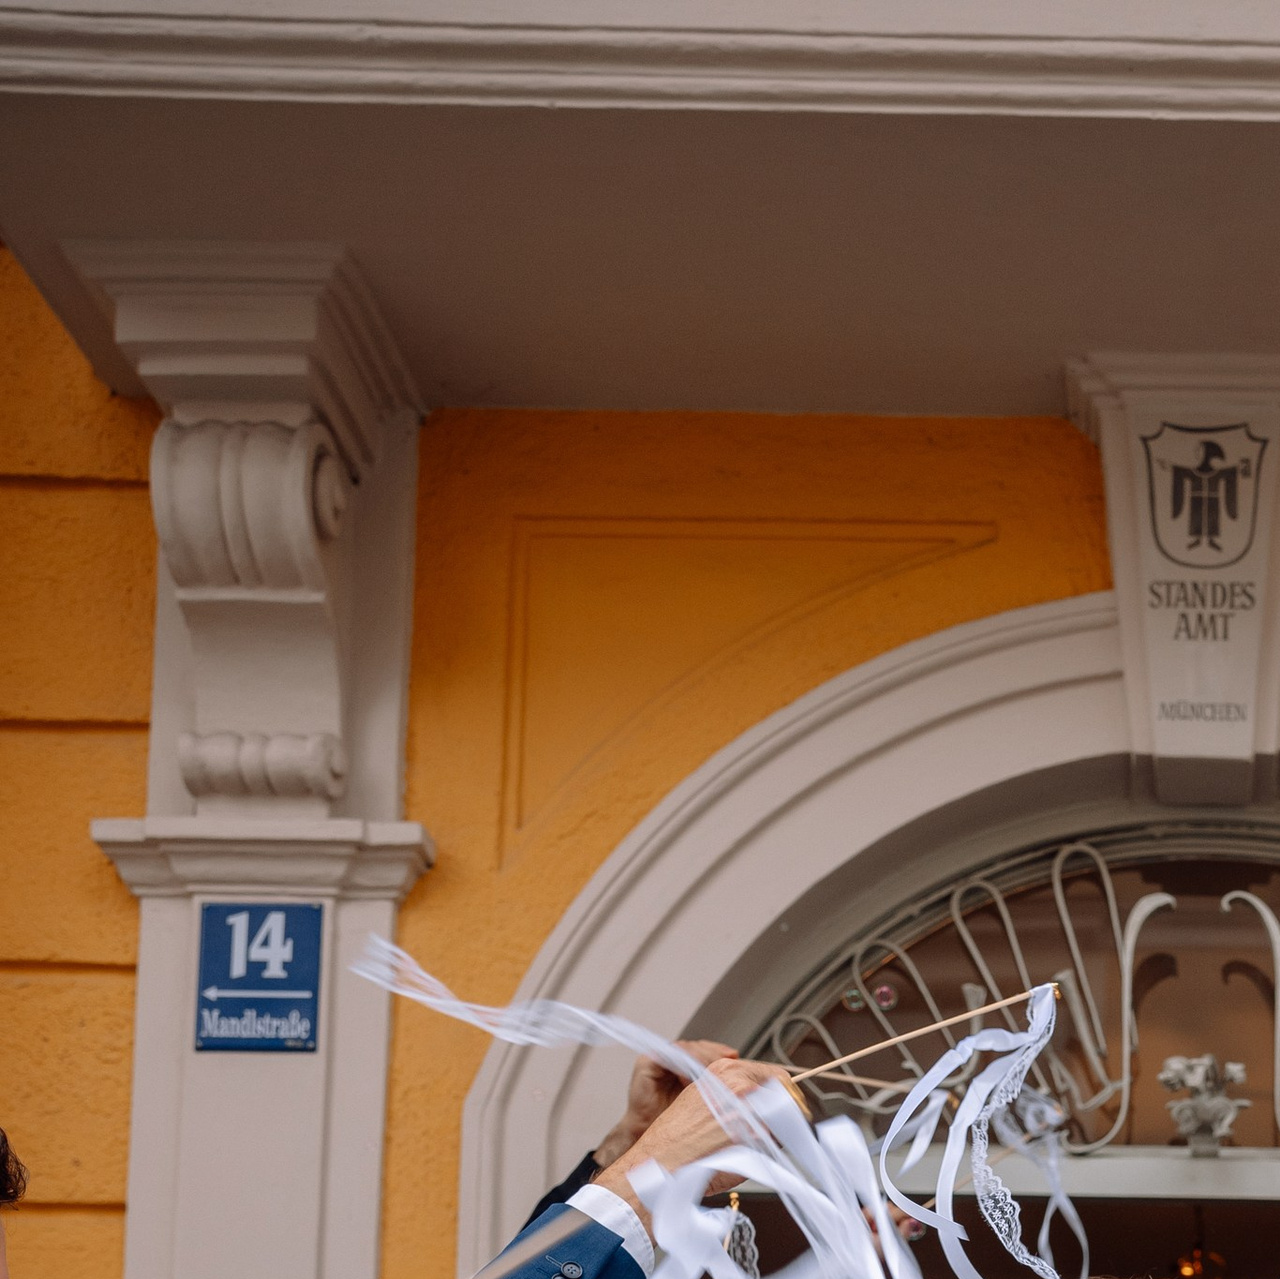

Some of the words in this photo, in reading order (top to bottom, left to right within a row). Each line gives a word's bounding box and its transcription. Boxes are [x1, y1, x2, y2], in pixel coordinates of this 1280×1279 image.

[1149, 581, 1255, 610] STANDES
[1174, 613, 1235, 641] AMT
[1159, 700, 1246, 722] MÜNCHEN
[226, 910, 294, 979] 14
[202, 1009, 311, 1039] Mandlstraße
